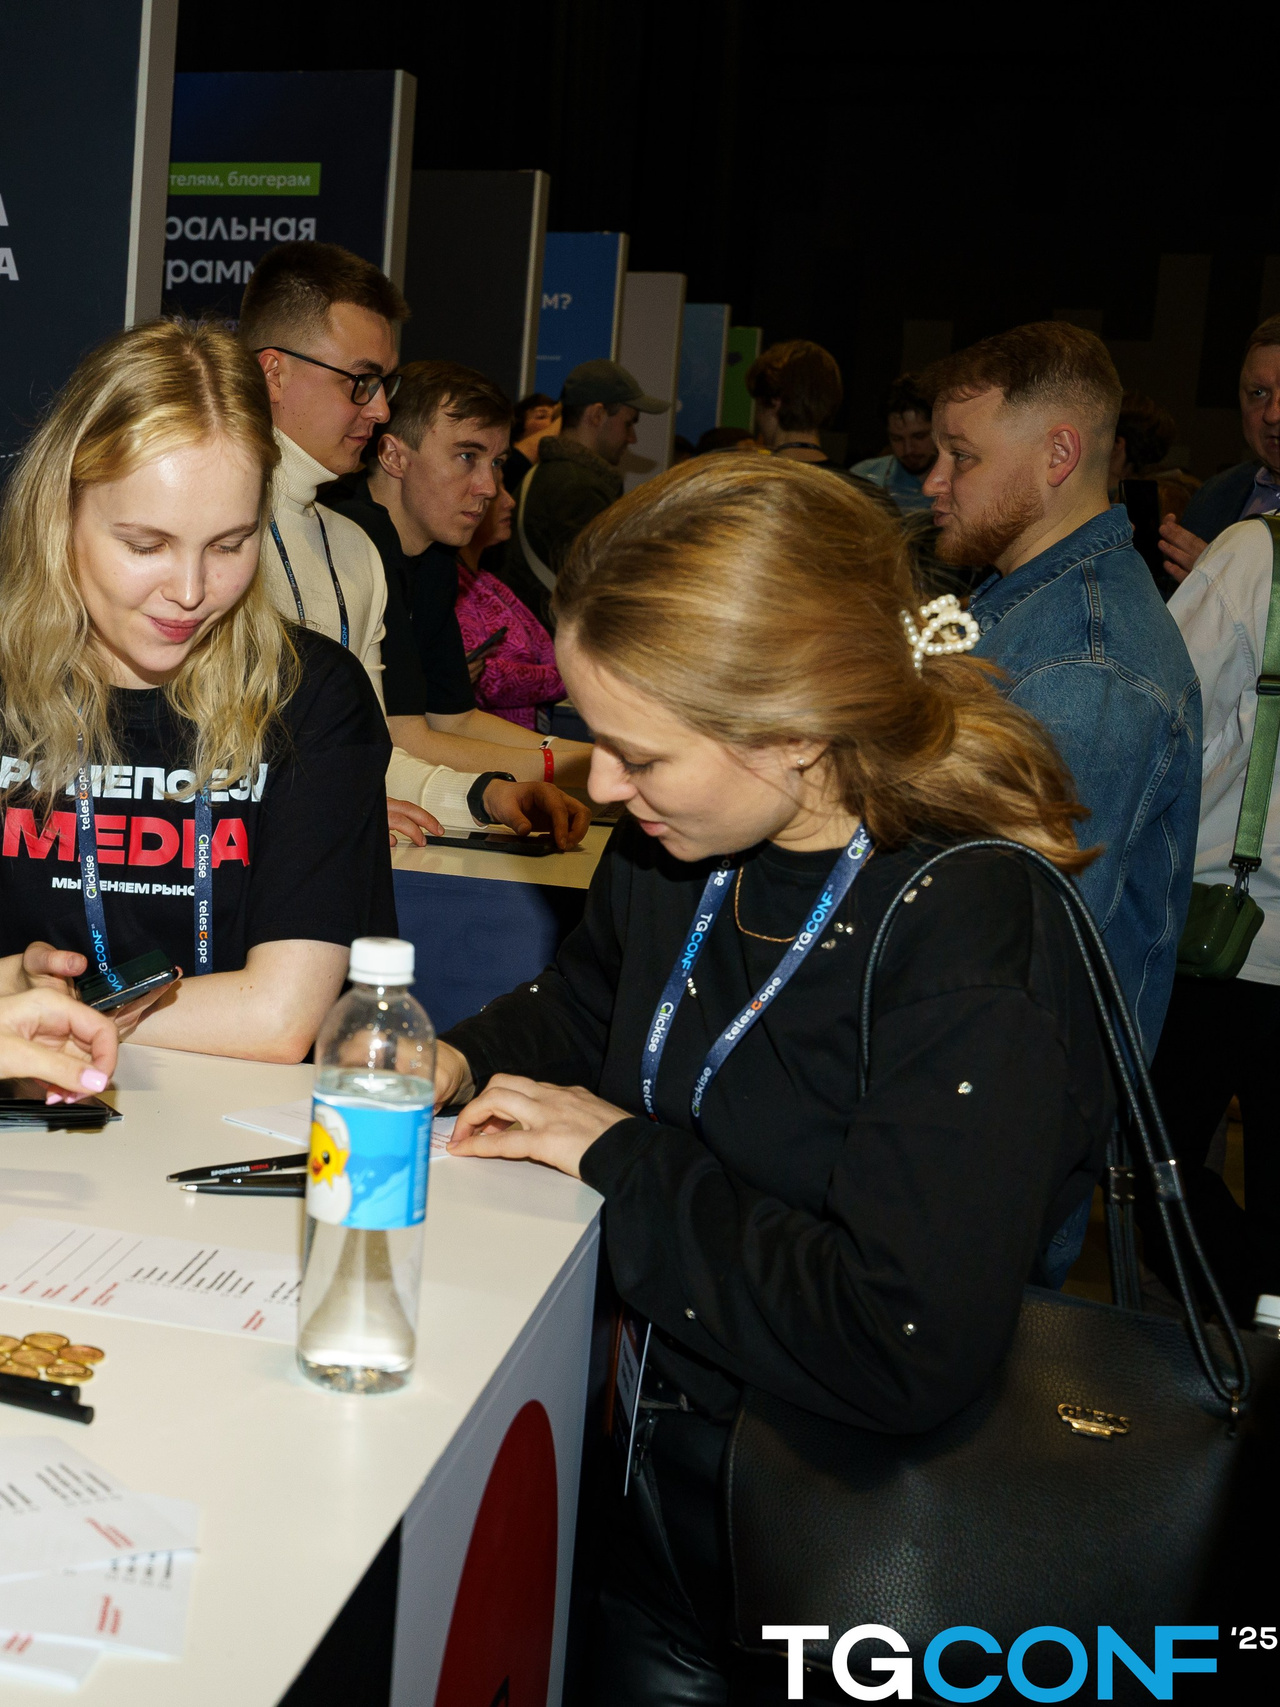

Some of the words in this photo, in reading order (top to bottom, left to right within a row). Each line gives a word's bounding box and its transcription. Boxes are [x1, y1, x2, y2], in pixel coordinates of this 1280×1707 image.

[227, 171, 311, 190] блогерам
[78, 767, 91, 831] telescope
[2, 807, 251, 869] MEDIA
[197, 834, 210, 878] Clickise
[847, 828, 870, 860] Clic
[51, 877, 81, 890] МЫ
[99, 880, 150, 895] ЕНЯЕМ
[86, 855, 98, 899] Clickise
[197, 900, 210, 964] telescope
[681, 912, 713, 970] TGCONF
[792, 891, 834, 952] TGCONF
[91, 929, 108, 974] GCONF
[648, 1001, 674, 1053] Clickise
[724, 977, 782, 1041] telescope
[691, 1067, 712, 1117] Clickise
